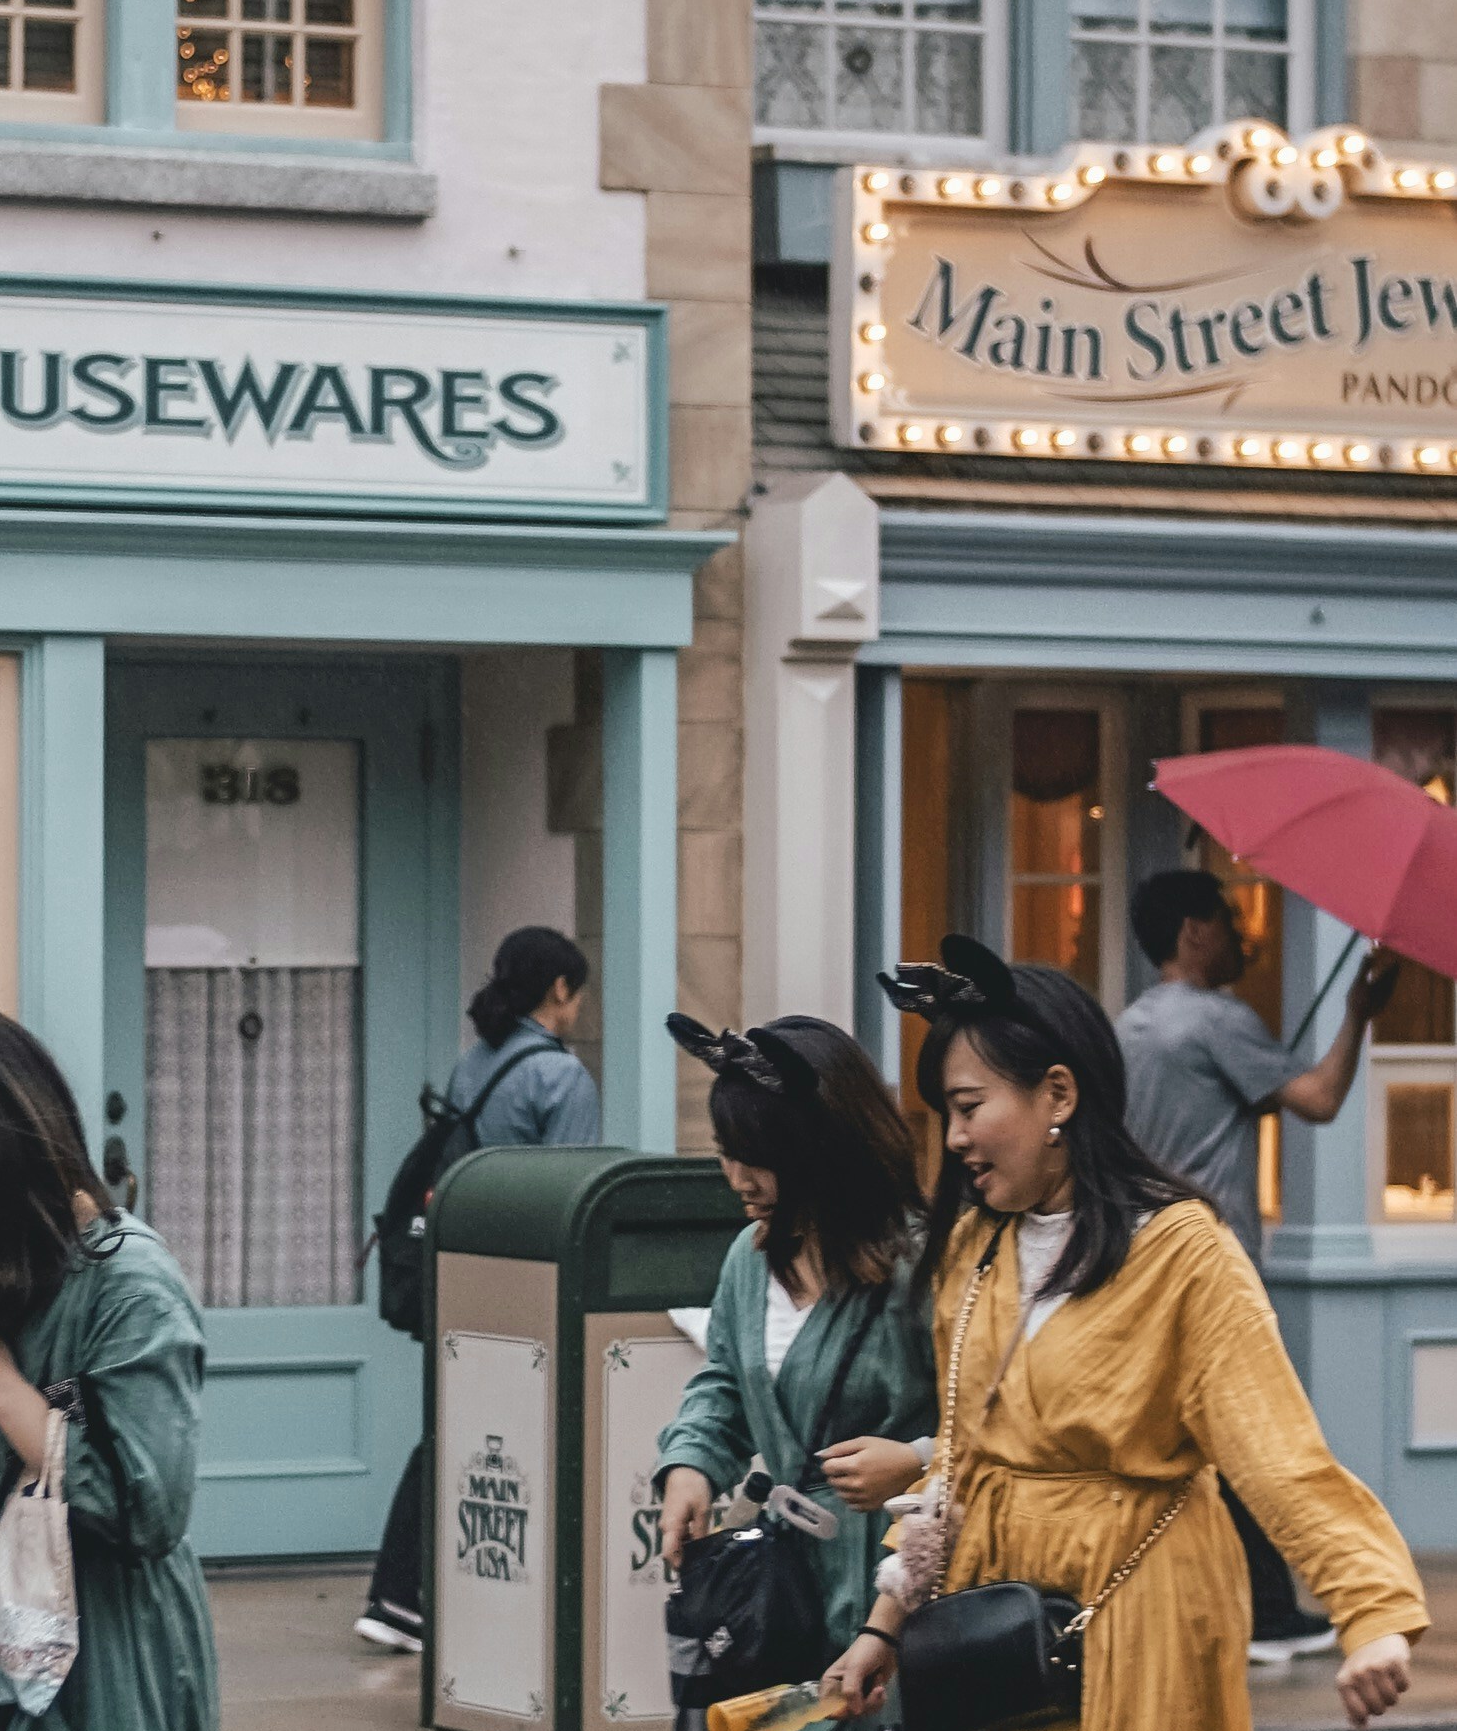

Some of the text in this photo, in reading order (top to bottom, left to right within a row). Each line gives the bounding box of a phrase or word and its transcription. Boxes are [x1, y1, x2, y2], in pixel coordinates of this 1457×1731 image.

[907, 255, 1105, 379] Main
[1124, 270, 1335, 380] Street
[200, 764, 301, 806] 318
[468, 1473, 520, 1504] MAIN
[457, 1498, 529, 1567] STREET
[475, 1546, 512, 1581] USA
